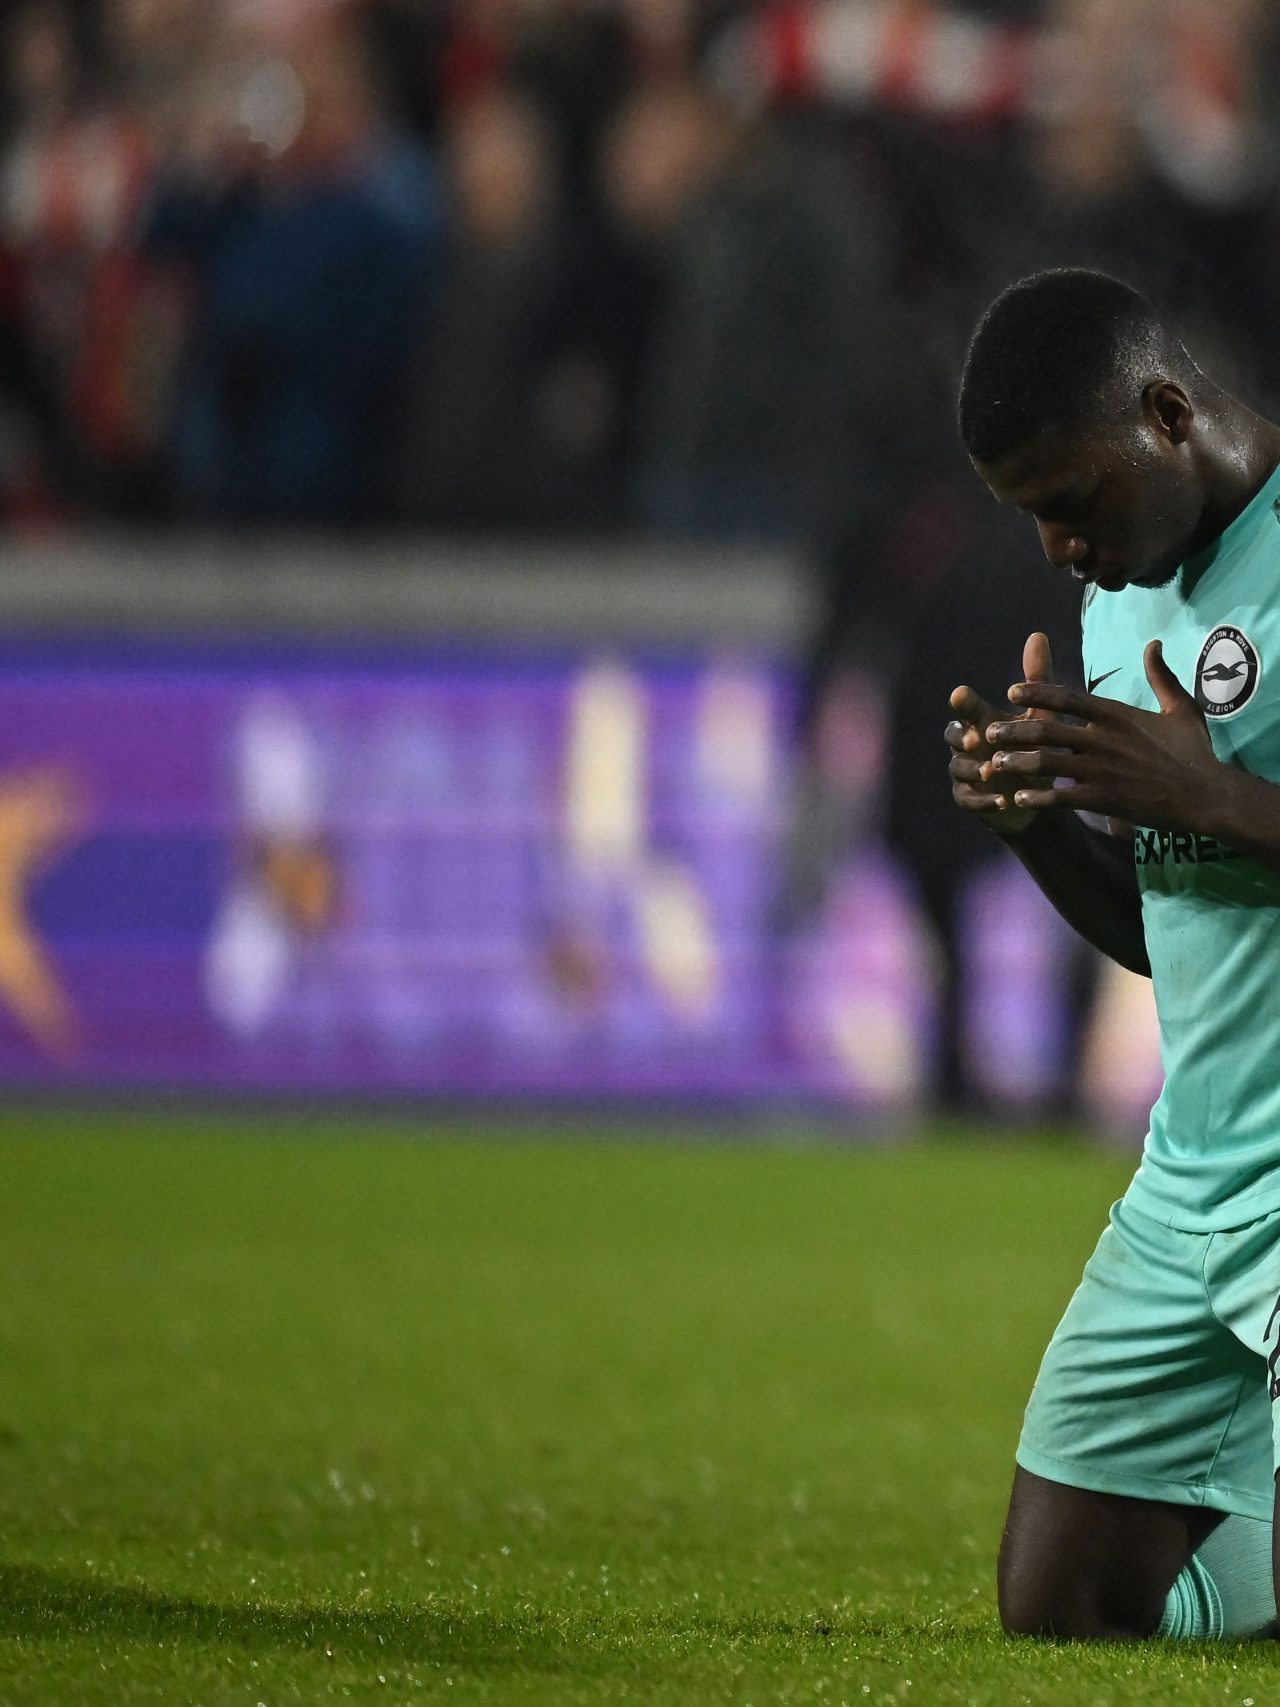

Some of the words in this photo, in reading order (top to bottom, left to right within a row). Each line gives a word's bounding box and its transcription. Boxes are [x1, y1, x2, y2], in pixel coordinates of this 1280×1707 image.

[1203, 630, 1227, 657] BRIGHTON
[1229, 631, 1234, 639] &
[1235, 633, 1250, 653] HOVE
[1206, 703, 1235, 713] ALBION
